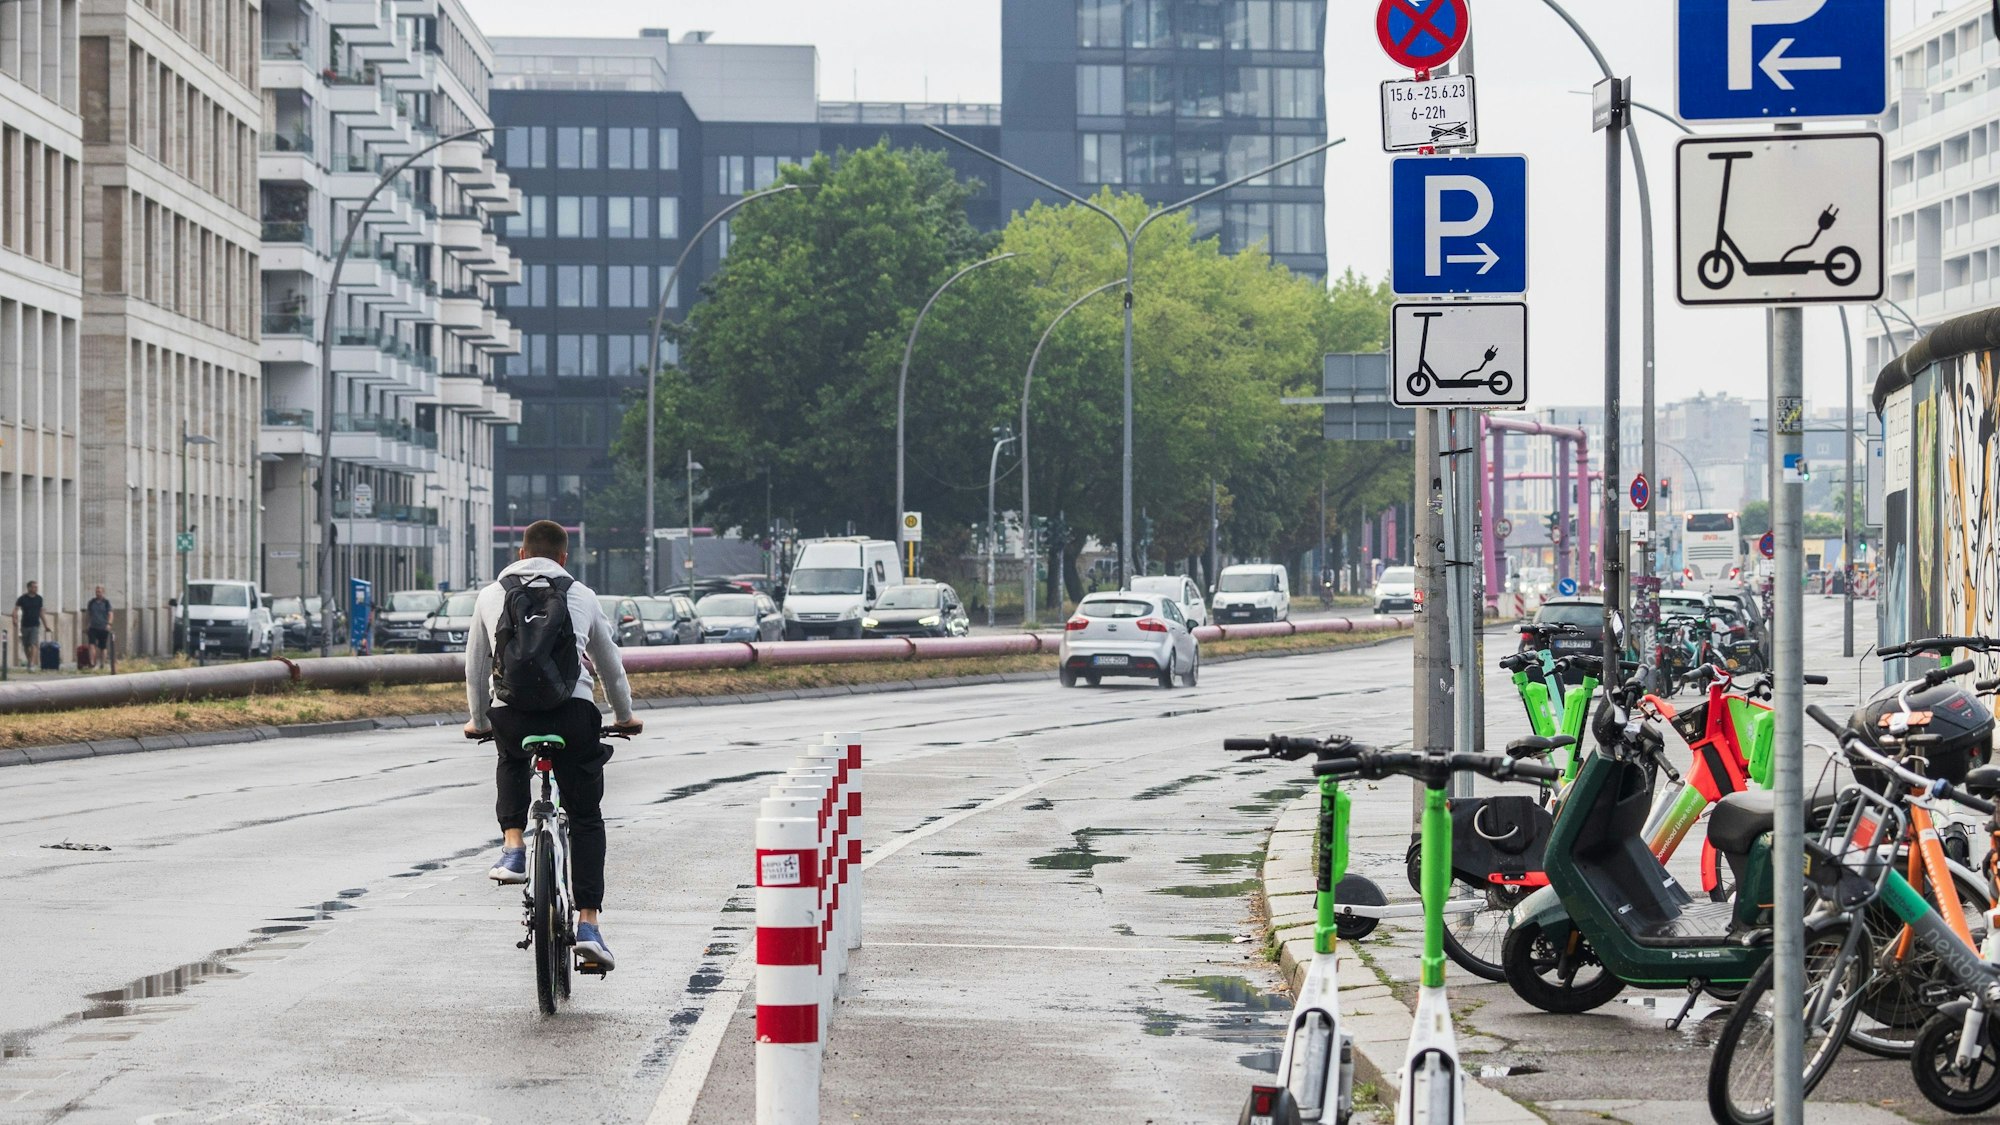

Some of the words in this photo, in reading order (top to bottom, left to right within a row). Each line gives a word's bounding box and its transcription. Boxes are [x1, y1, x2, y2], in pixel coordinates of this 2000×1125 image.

[1390, 84, 1466, 102] 15.6.-25.6.23
[1411, 105, 1446, 120] 6-22h
[1425, 175, 1494, 276] P
[1674, 813, 1688, 830] Lime
[1924, 928, 1990, 996] nextbik
